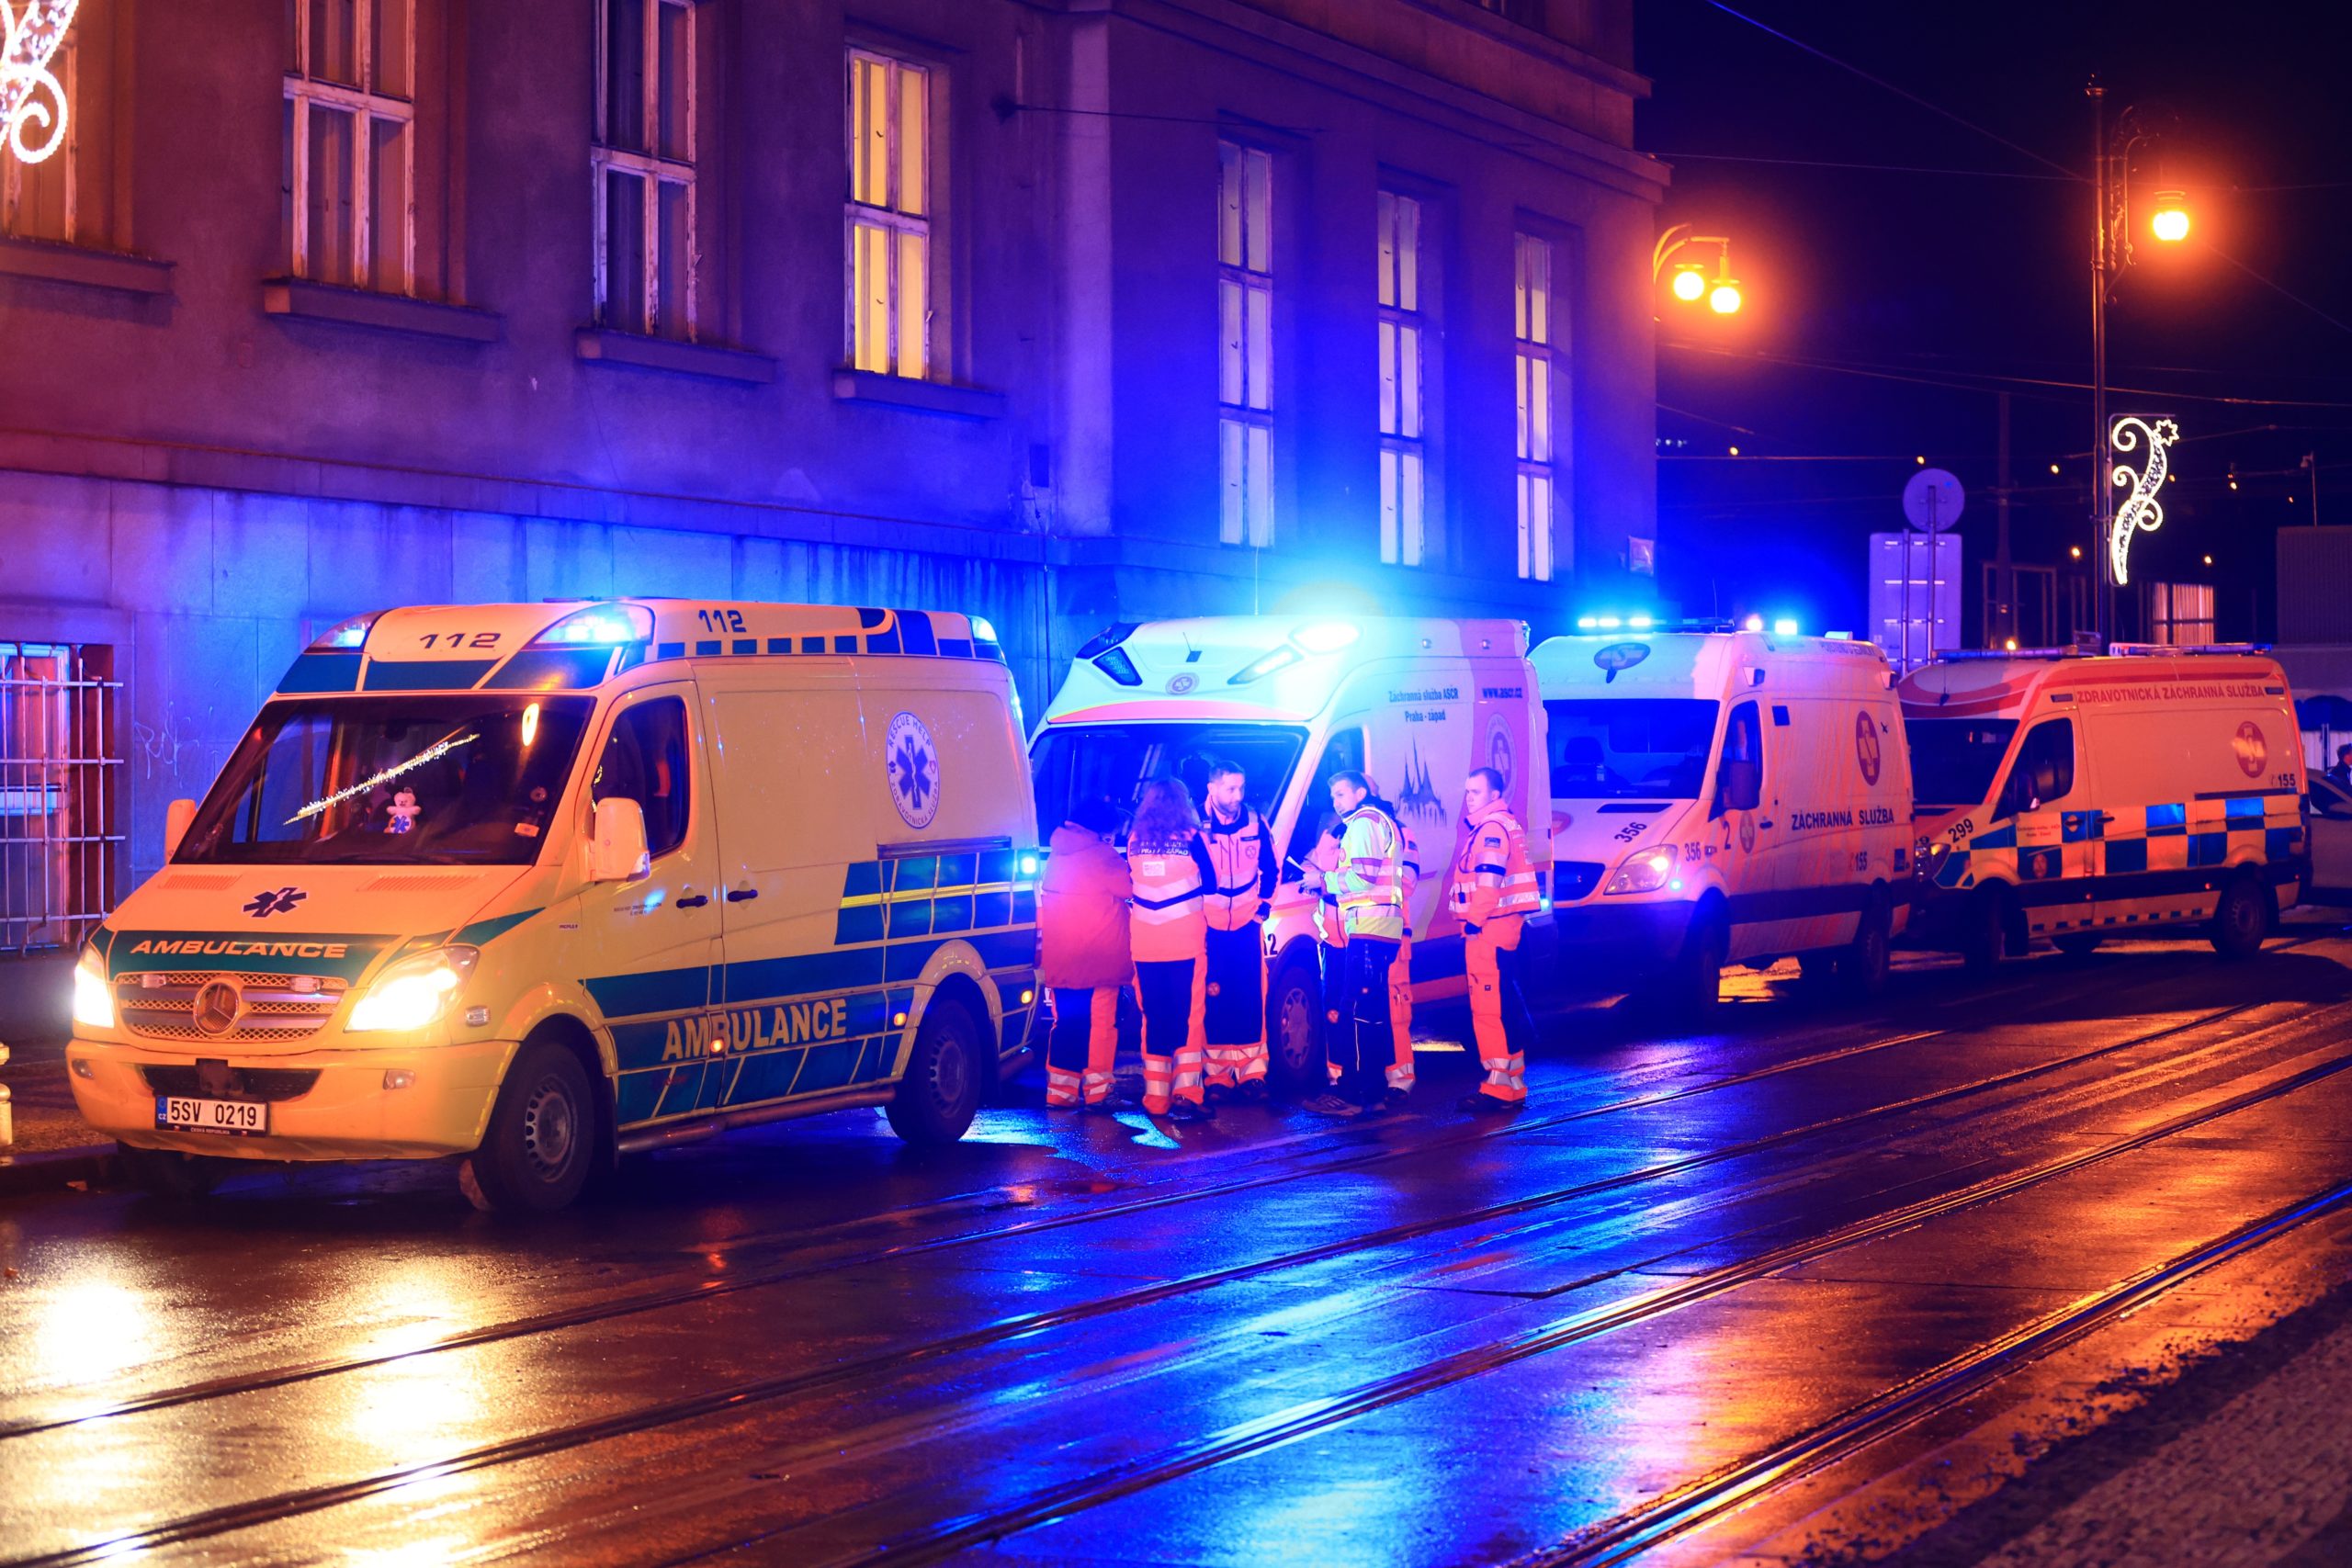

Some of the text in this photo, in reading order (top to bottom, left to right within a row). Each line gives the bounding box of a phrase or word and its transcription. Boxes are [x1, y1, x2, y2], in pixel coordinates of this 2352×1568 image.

[698, 609, 747, 633] 112
[420, 633, 501, 649] 112
[1482, 687, 1523, 699] www.ascr.cz
[2076, 683, 2265, 704] ZDRAVOTNICKÁ ZÁCHRANNÁ SLUŽBA
[1405, 711, 1424, 723] Praha
[1428, 709, 1446, 723] západ
[888, 716, 931, 748] RESCUE HELP
[2278, 773, 2296, 787] 155
[1792, 806, 1894, 830] ZÁCHRANNÁ SLUŽBA
[1614, 822, 1647, 842] 356
[1948, 818, 1973, 843] 299
[1685, 841, 1701, 862] 356
[1855, 851, 1868, 872] 155
[130, 940, 348, 958] AMBULANCE
[662, 998, 846, 1061] AMBULANCE
[171, 1100, 256, 1127] 5SV 0219
